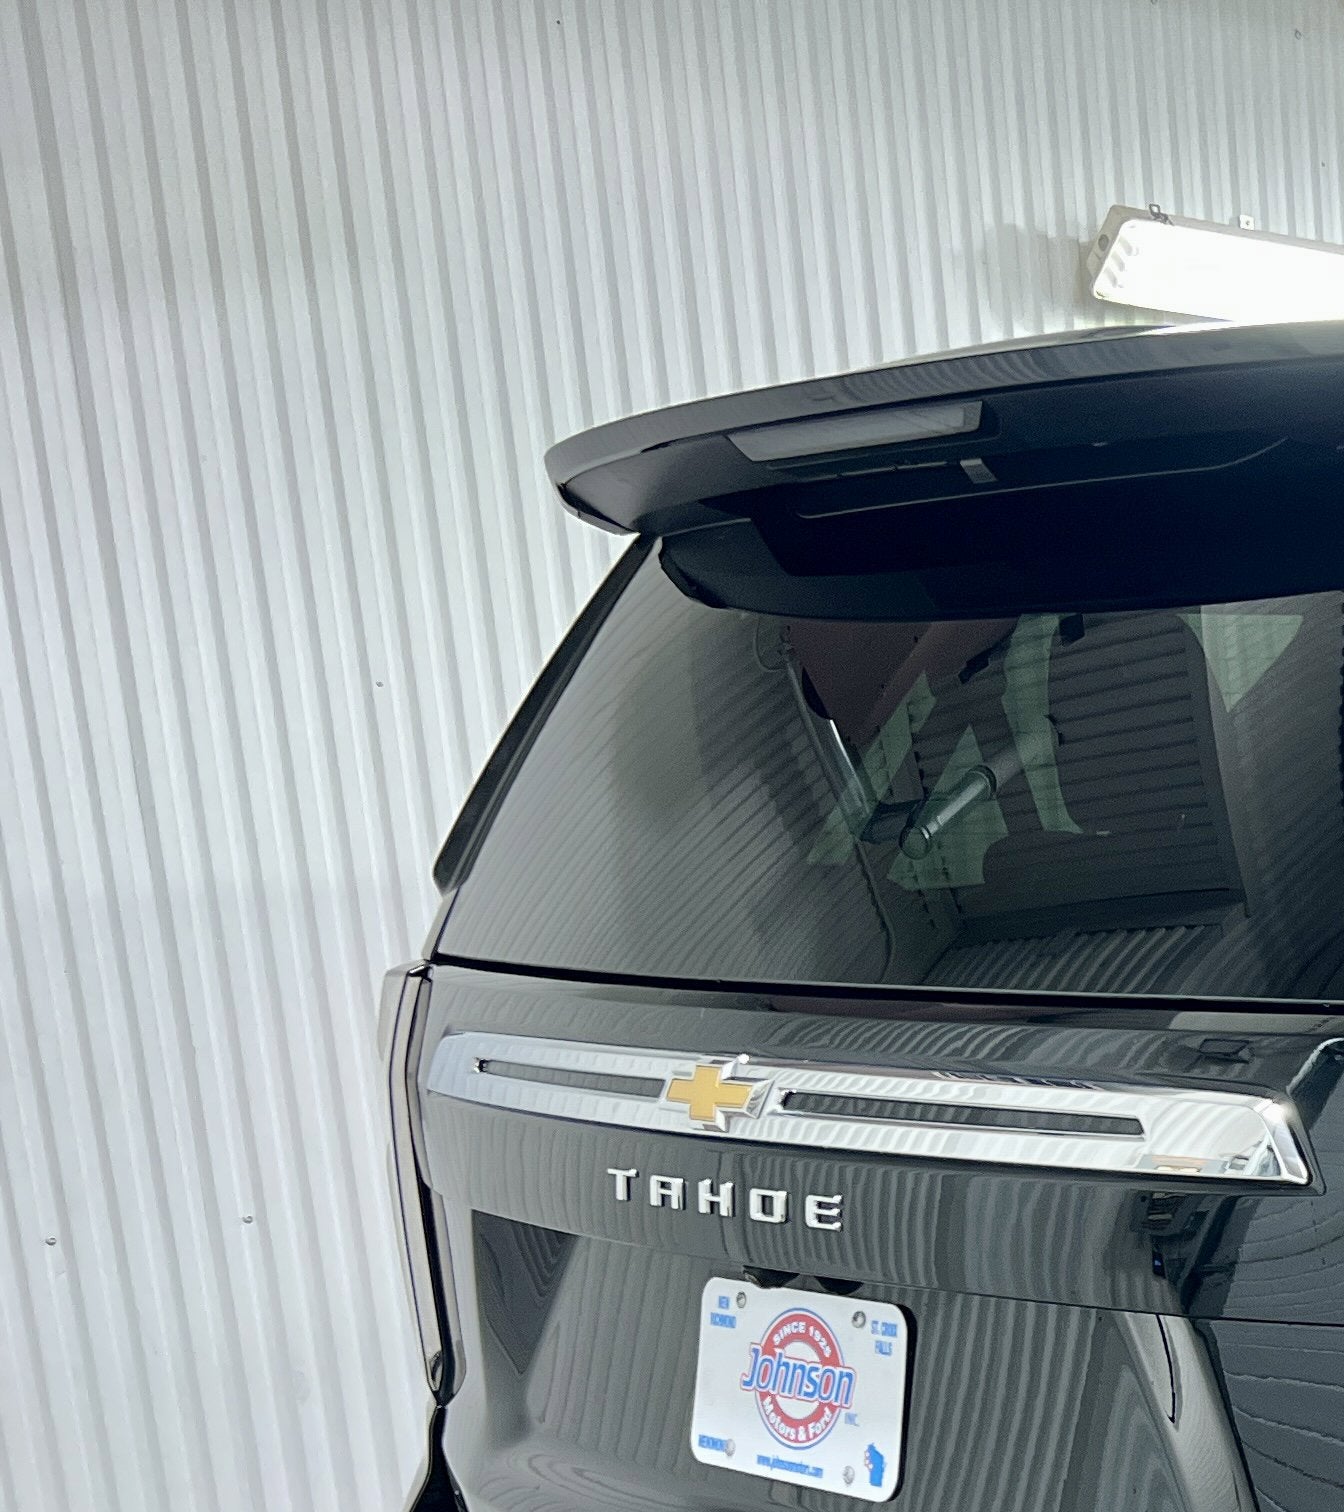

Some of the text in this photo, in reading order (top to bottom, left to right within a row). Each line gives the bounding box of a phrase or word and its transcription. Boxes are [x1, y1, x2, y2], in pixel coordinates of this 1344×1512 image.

[607, 1168, 842, 1231] TAHOE
[773, 1321, 806, 1345] SINCE
[742, 1347, 854, 1405] Johnson
[763, 1395, 833, 1441] Motors & Ford
